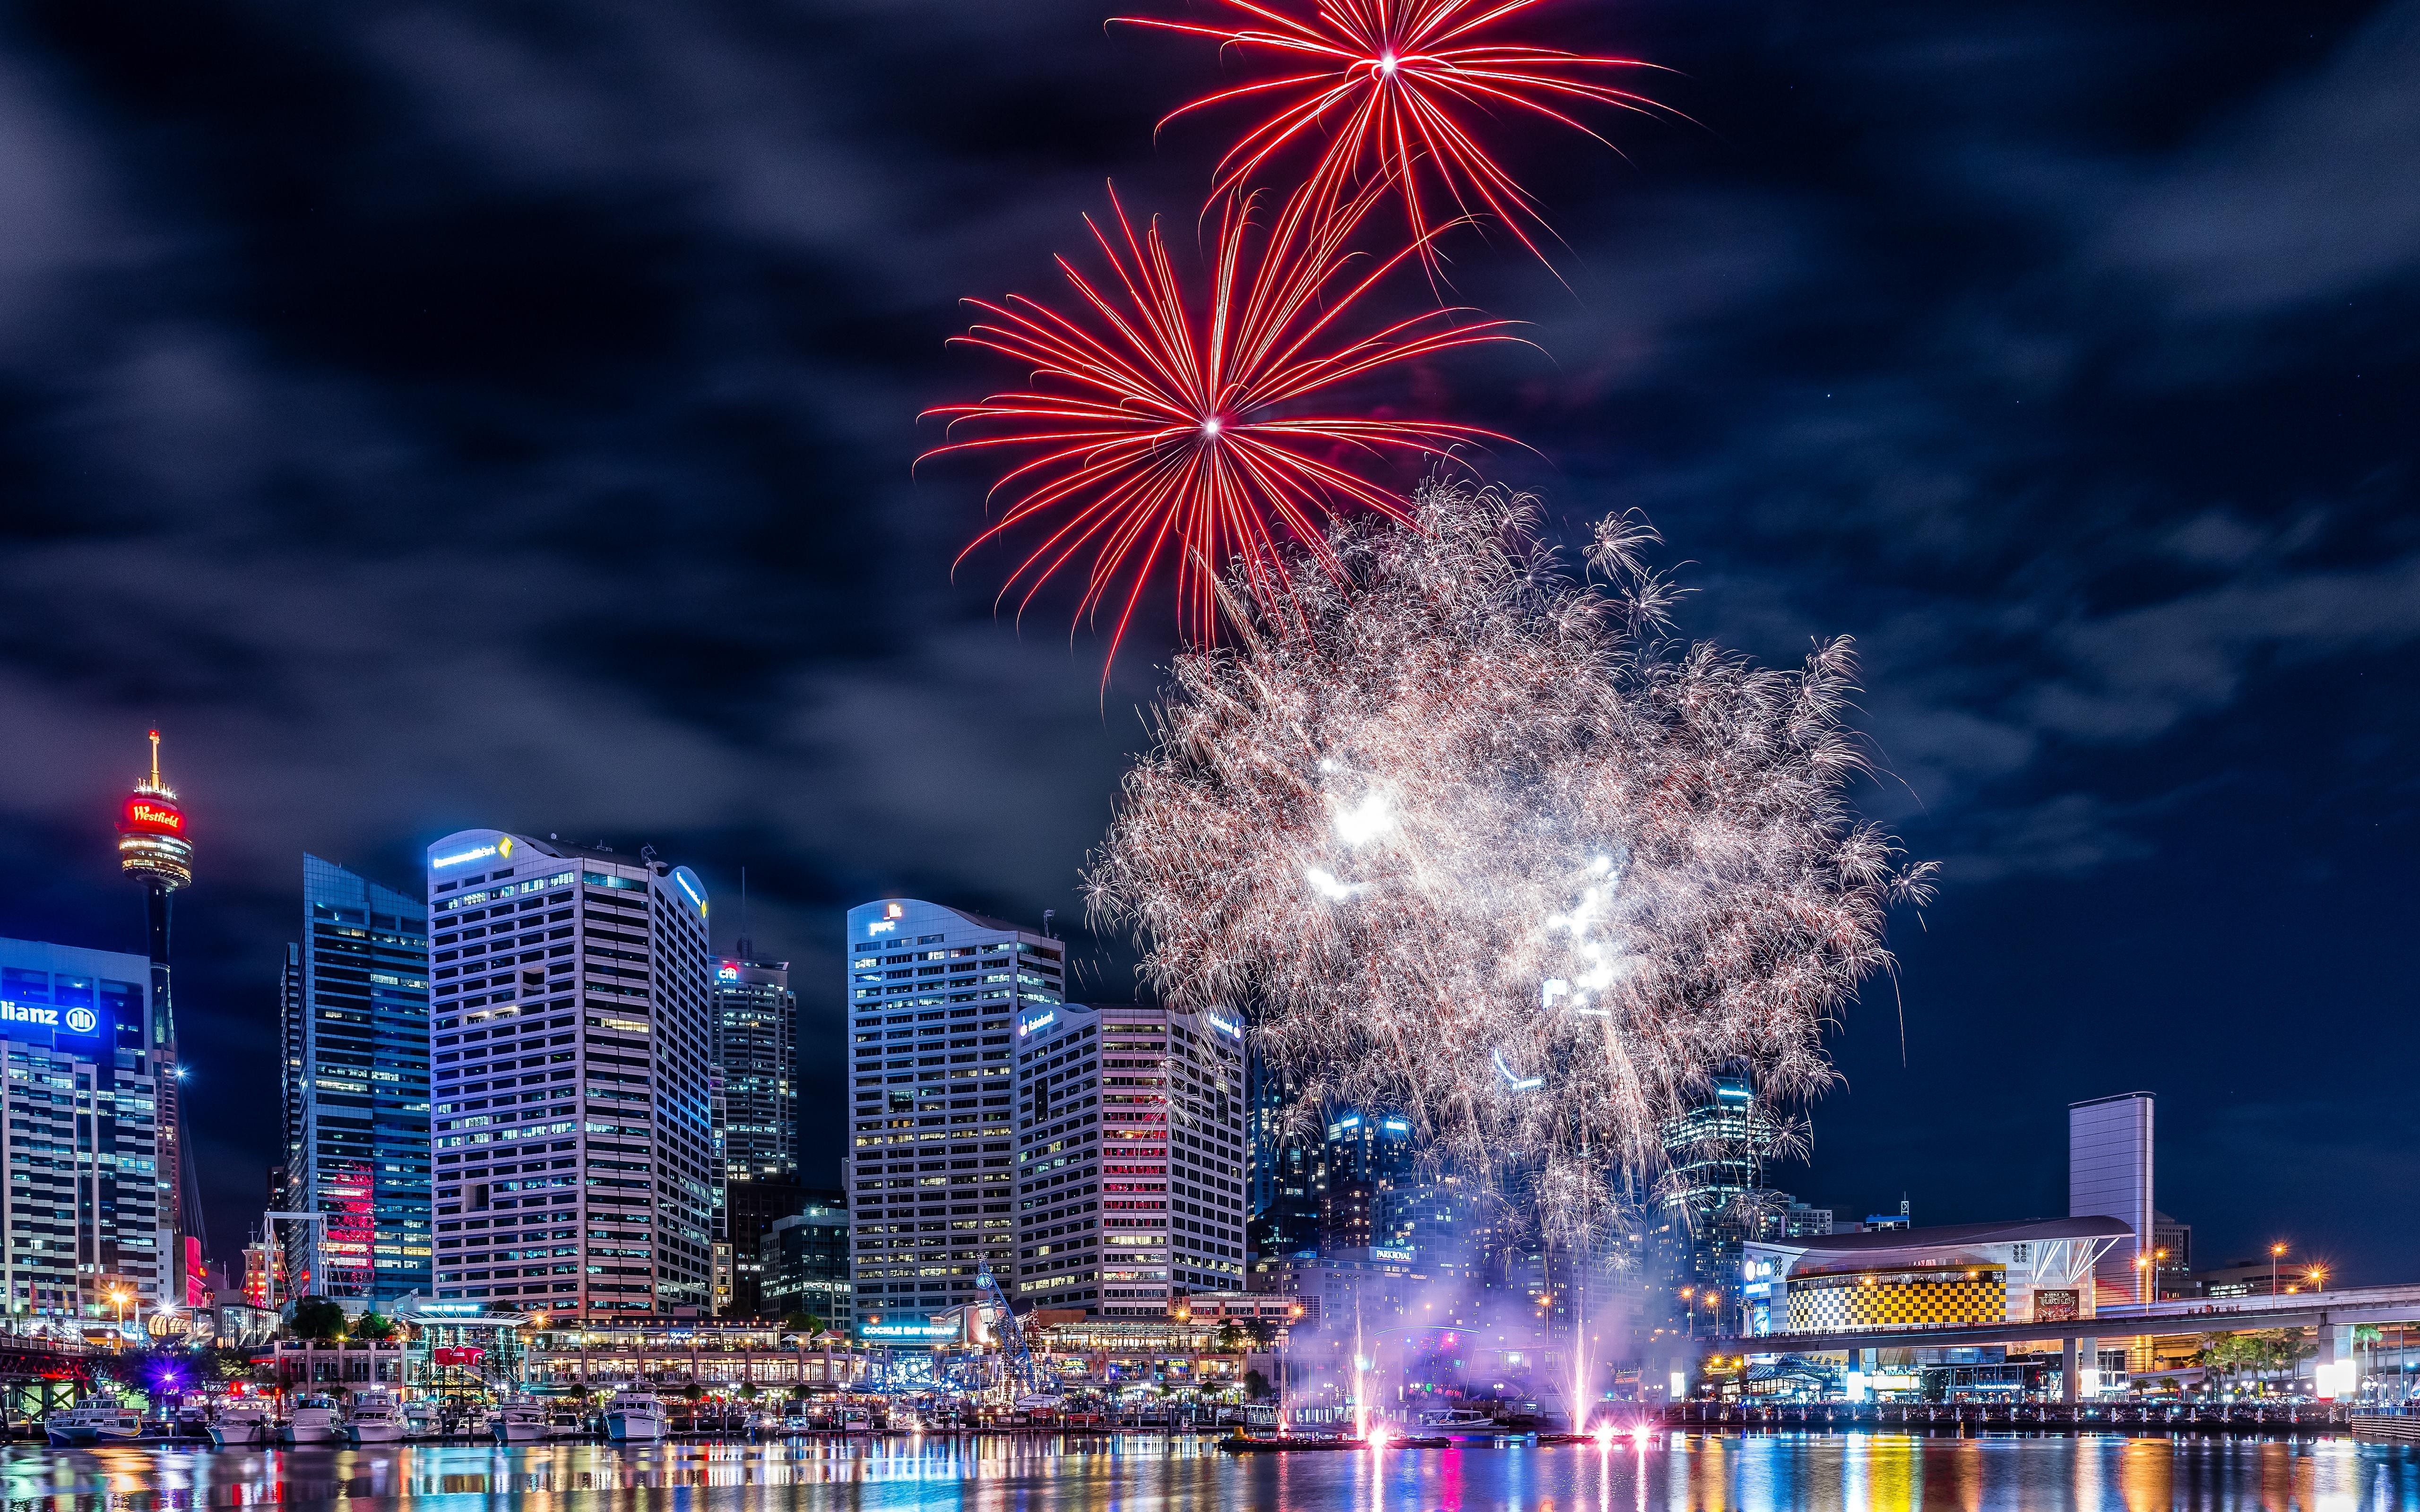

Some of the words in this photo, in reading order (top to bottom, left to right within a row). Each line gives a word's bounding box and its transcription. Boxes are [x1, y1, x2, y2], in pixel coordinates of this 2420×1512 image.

[134, 806, 179, 827] Westfield
[870, 921, 895, 936] pwc
[719, 968, 736, 980] citi
[1376, 1250, 1412, 1260] PARKROYAL
[1756, 1262, 1771, 1276] LG
[2038, 1297, 2075, 1306] TURTLES
[863, 1326, 902, 1335] COCKLE
[903, 1326, 921, 1335] BAY
[922, 1327, 957, 1335] WHARF
